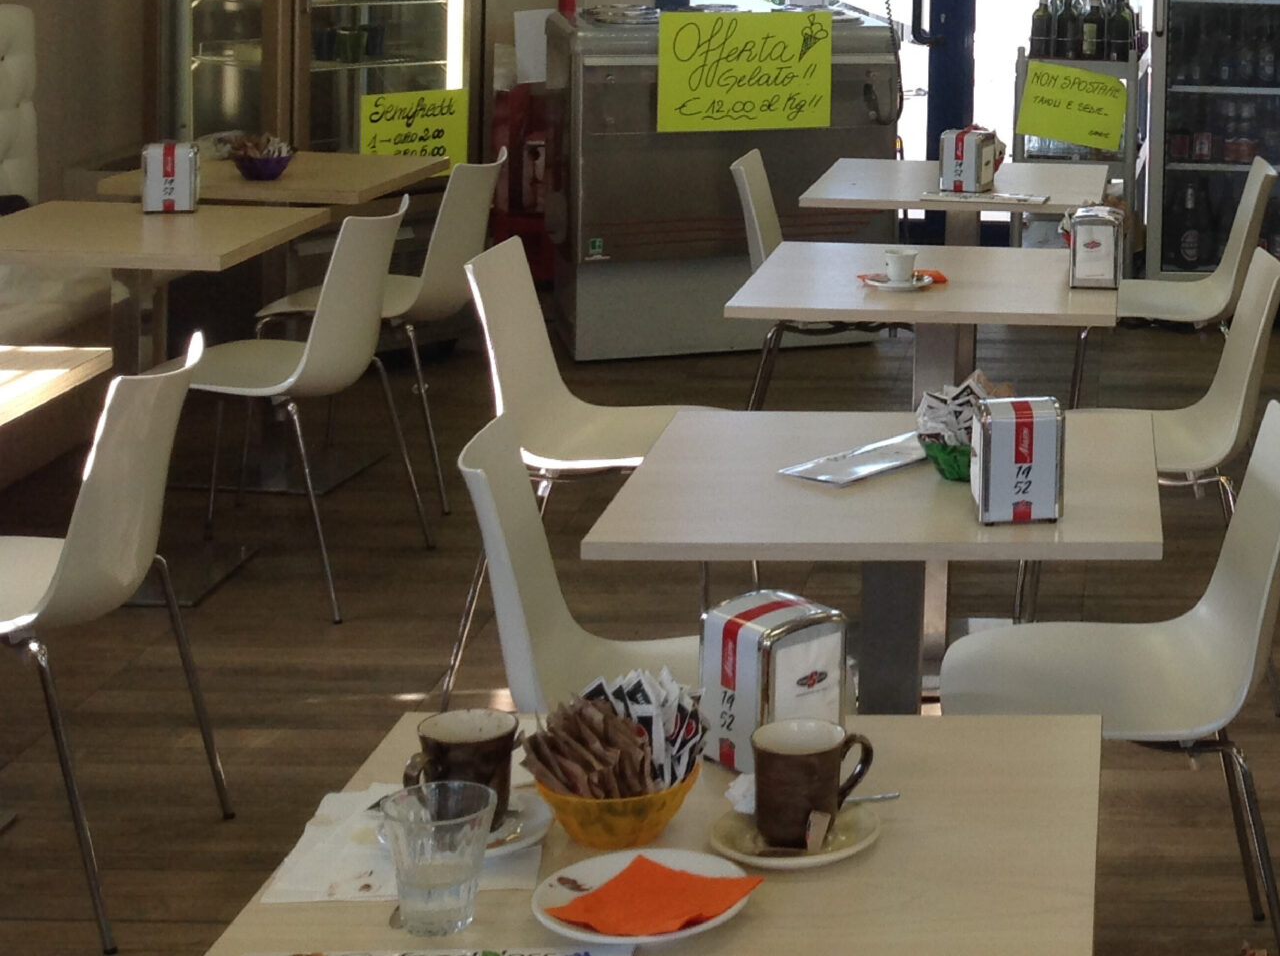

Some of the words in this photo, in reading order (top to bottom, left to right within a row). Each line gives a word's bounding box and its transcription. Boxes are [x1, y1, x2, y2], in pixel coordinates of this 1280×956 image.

[673, 17, 796, 92] Offerta
[1031, 72, 1059, 89] NON
[1060, 75, 1121, 99] SPOSTARE
[1065, 100, 1074, 110] E
[1014, 480, 1033, 495] 52
[720, 711, 736, 732] 52
